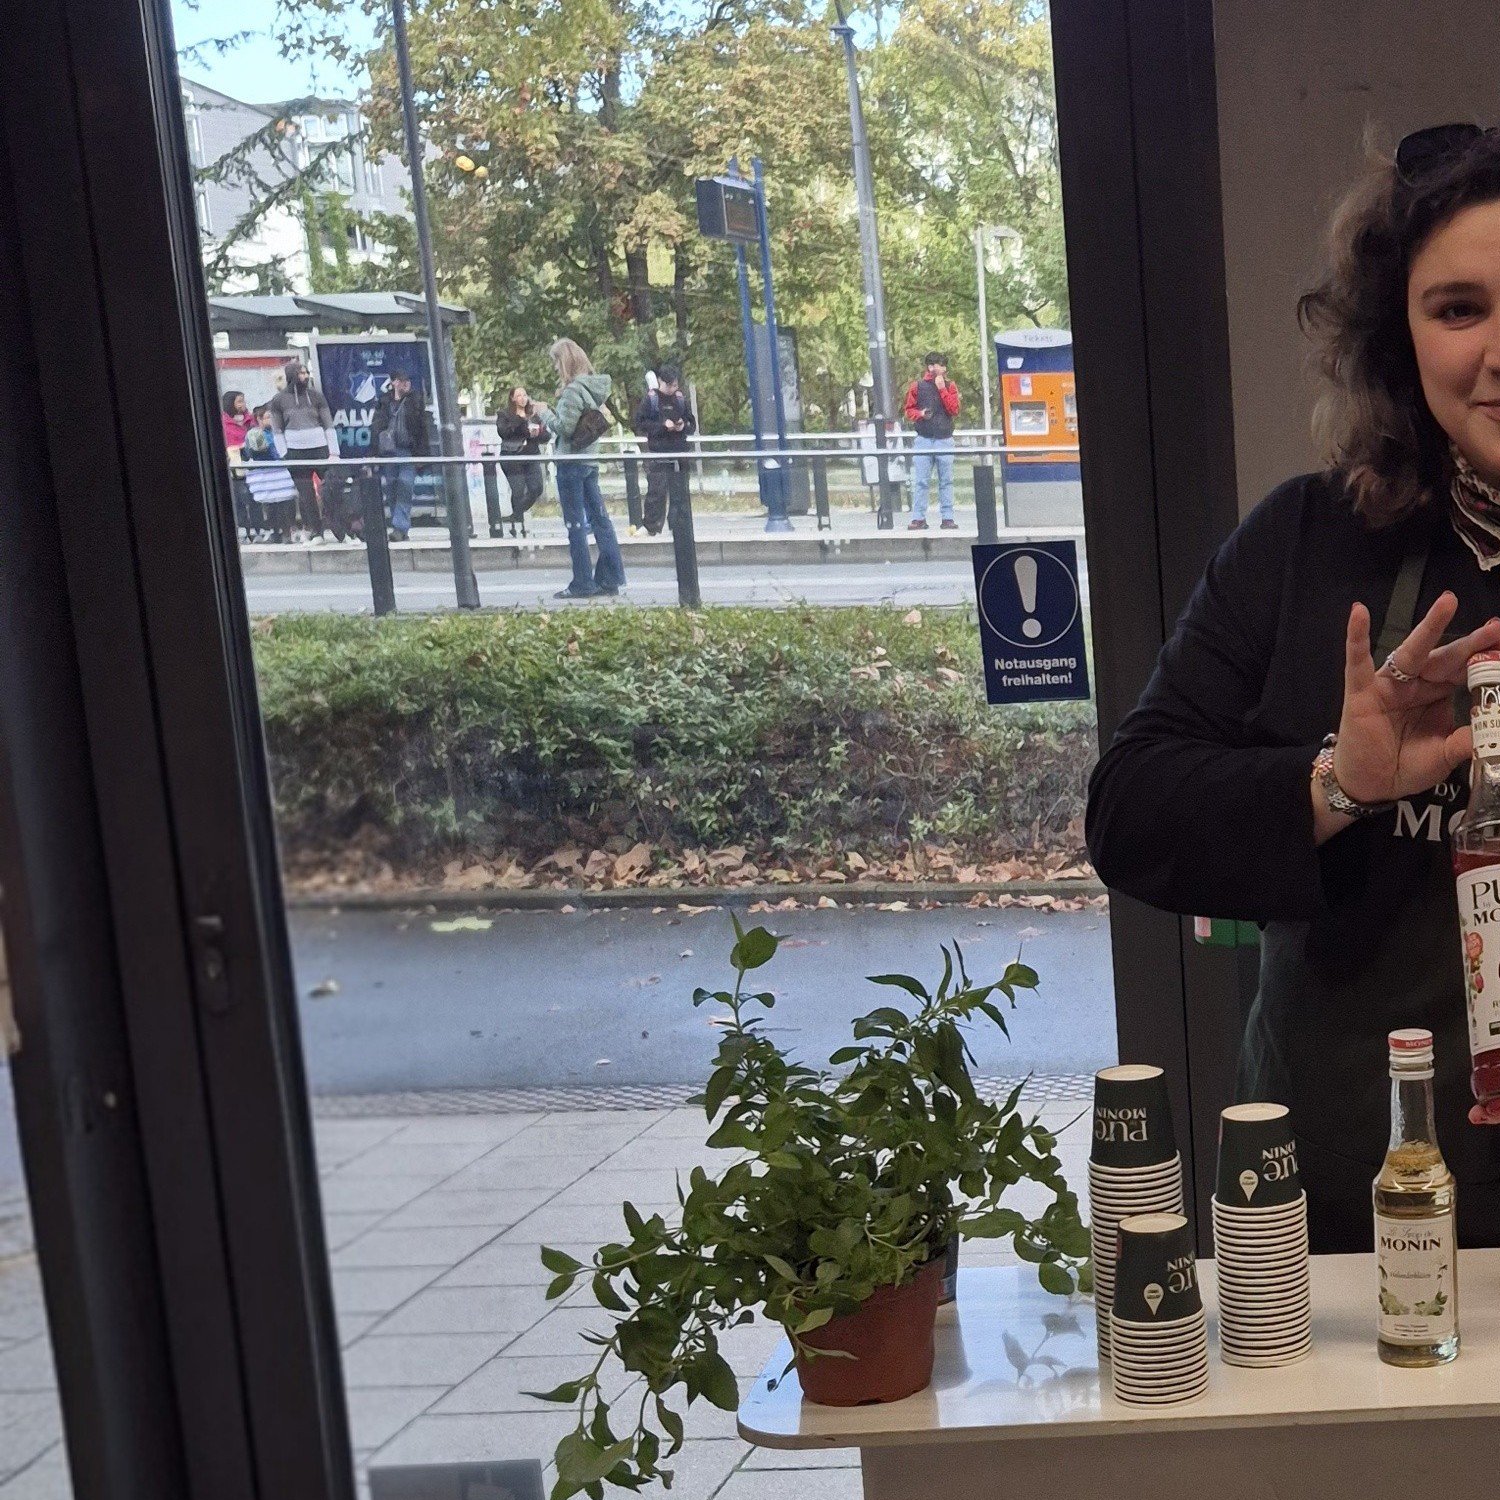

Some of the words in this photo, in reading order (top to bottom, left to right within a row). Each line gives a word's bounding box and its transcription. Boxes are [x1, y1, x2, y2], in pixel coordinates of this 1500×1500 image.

[995, 657, 1077, 671] Notausgang
[1002, 672, 1072, 687] freihalten!
[1434, 781, 1461, 801] by
[1262, 1139, 1296, 1160] ONIN
[1262, 1154, 1300, 1182] ure
[1380, 1235, 1441, 1252] MONIN
